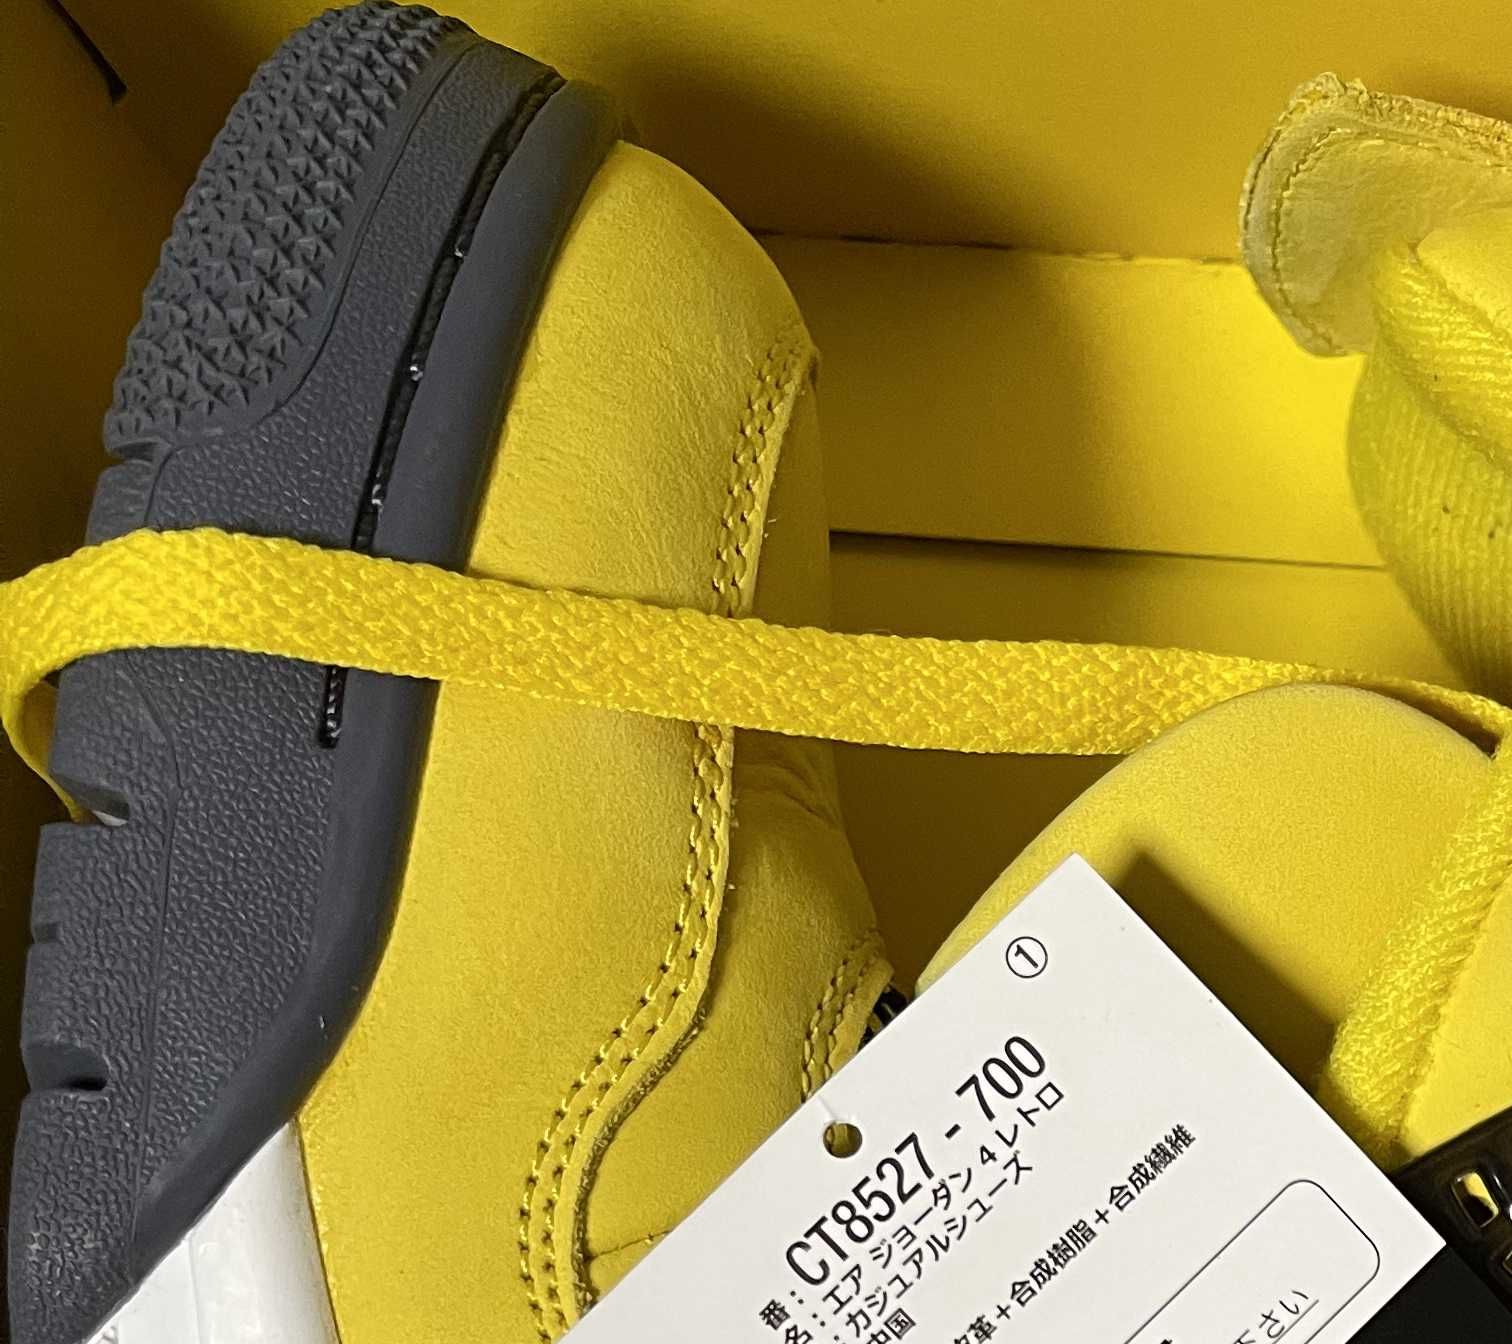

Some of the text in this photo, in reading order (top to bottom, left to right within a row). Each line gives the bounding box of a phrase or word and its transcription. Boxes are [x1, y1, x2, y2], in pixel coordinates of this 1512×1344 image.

[1005, 936, 1049, 979] ①
[785, 1131, 935, 1286] CT8527
[954, 1036, 1046, 1122] 700
[821, 1263, 862, 1316] エア
[868, 1167, 972, 1270] ジョーダン
[979, 1144, 998, 1166] 4
[994, 1081, 1065, 1149] レトロ
[845, 1149, 1033, 1339] カジュアルシューズ
